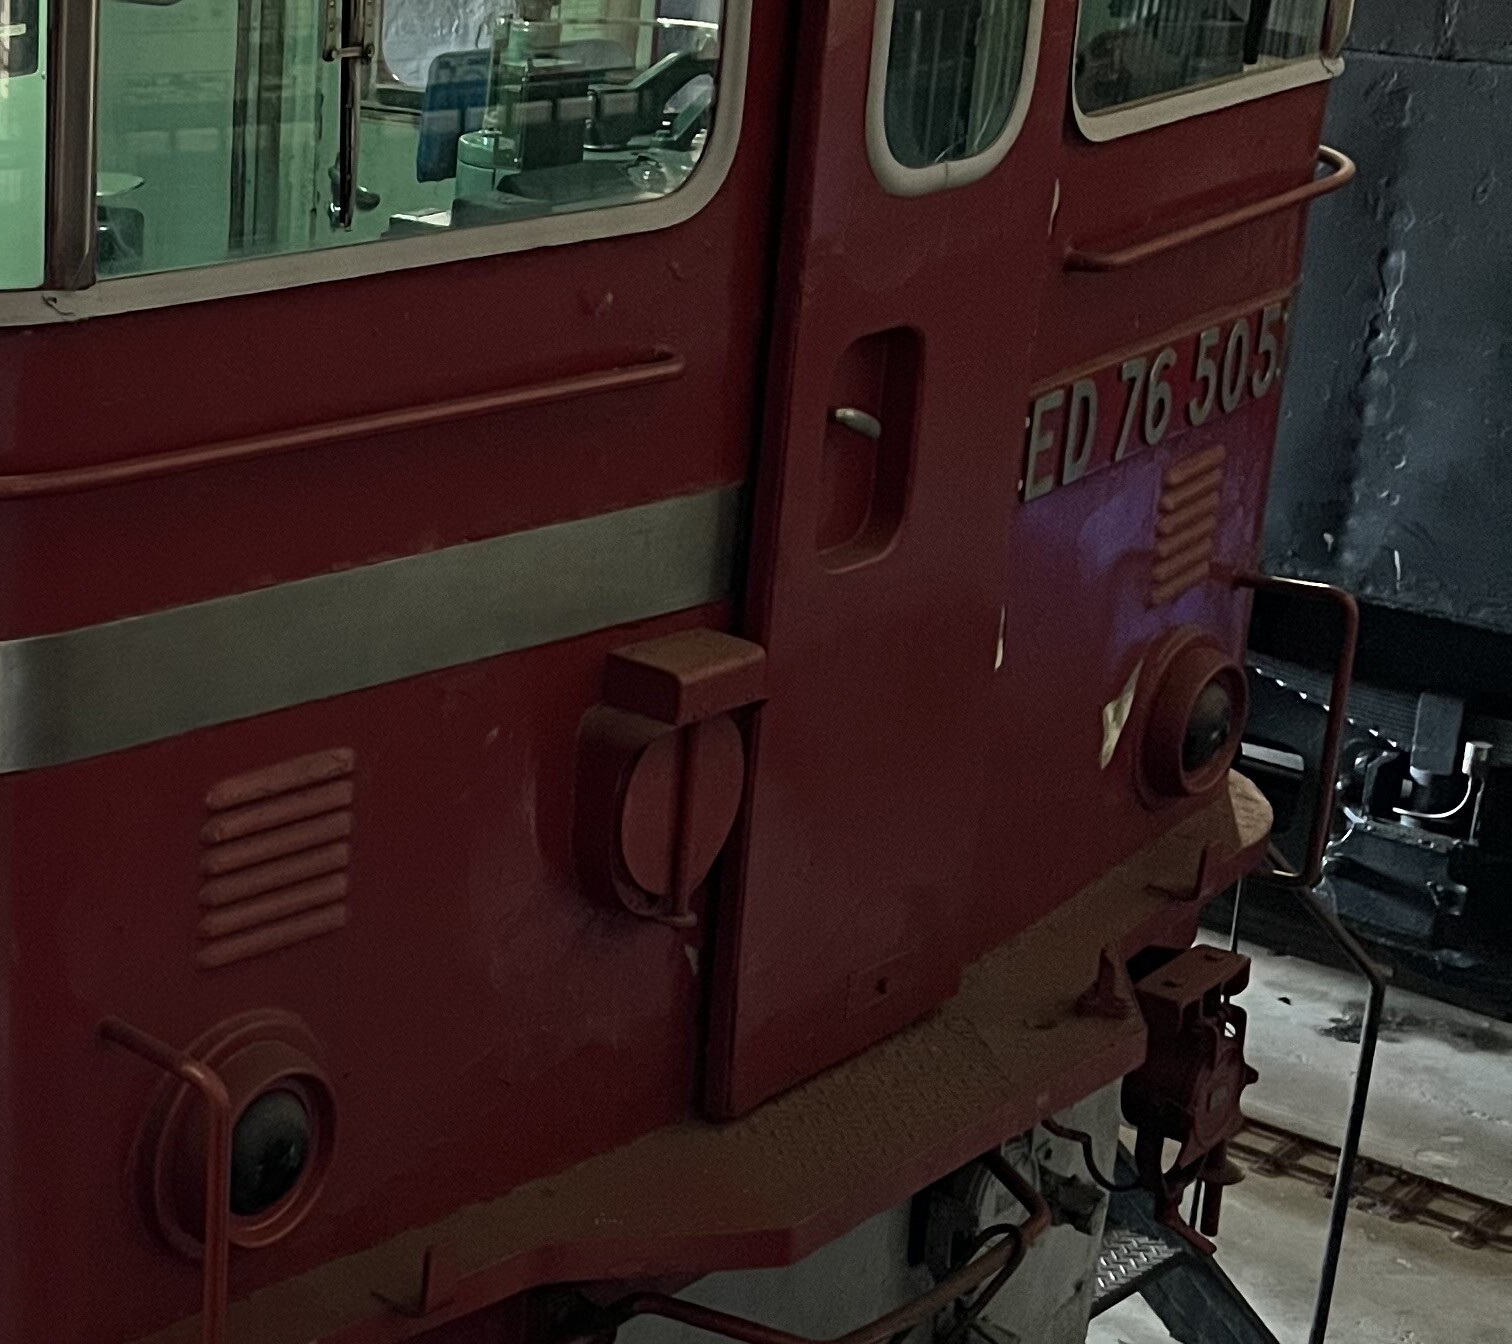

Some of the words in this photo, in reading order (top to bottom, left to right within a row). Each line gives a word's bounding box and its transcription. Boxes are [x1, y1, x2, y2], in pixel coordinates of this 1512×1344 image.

[1024, 377, 1098, 503] ED
[1114, 347, 1178, 462] 76
[1189, 302, 1282, 427] 505
